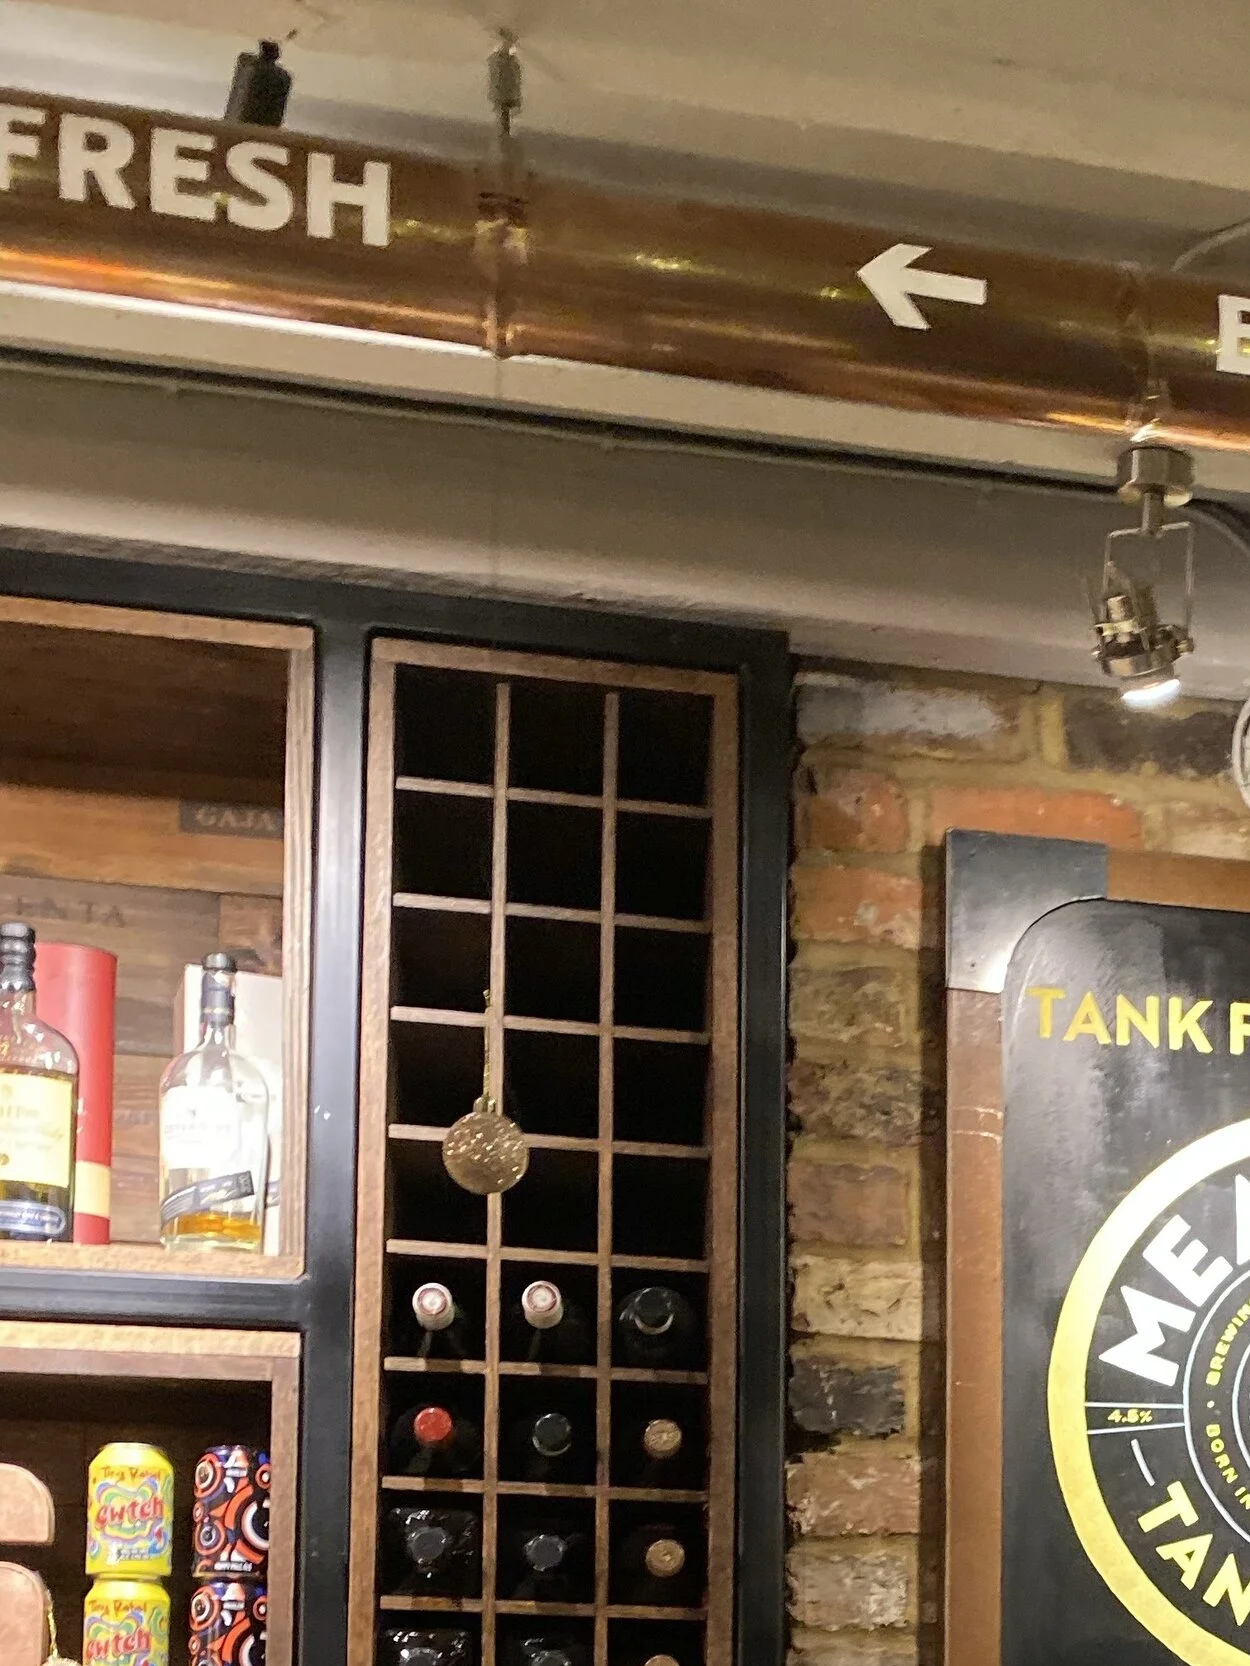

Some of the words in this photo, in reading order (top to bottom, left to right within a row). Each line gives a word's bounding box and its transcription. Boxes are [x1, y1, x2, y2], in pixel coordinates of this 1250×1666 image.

[0, 105, 391, 248] FRESH
[1029, 987, 1214, 1054] TANK
[1107, 1408, 1153, 1424] 4.5%
[1205, 1423, 1238, 1484] BORN
